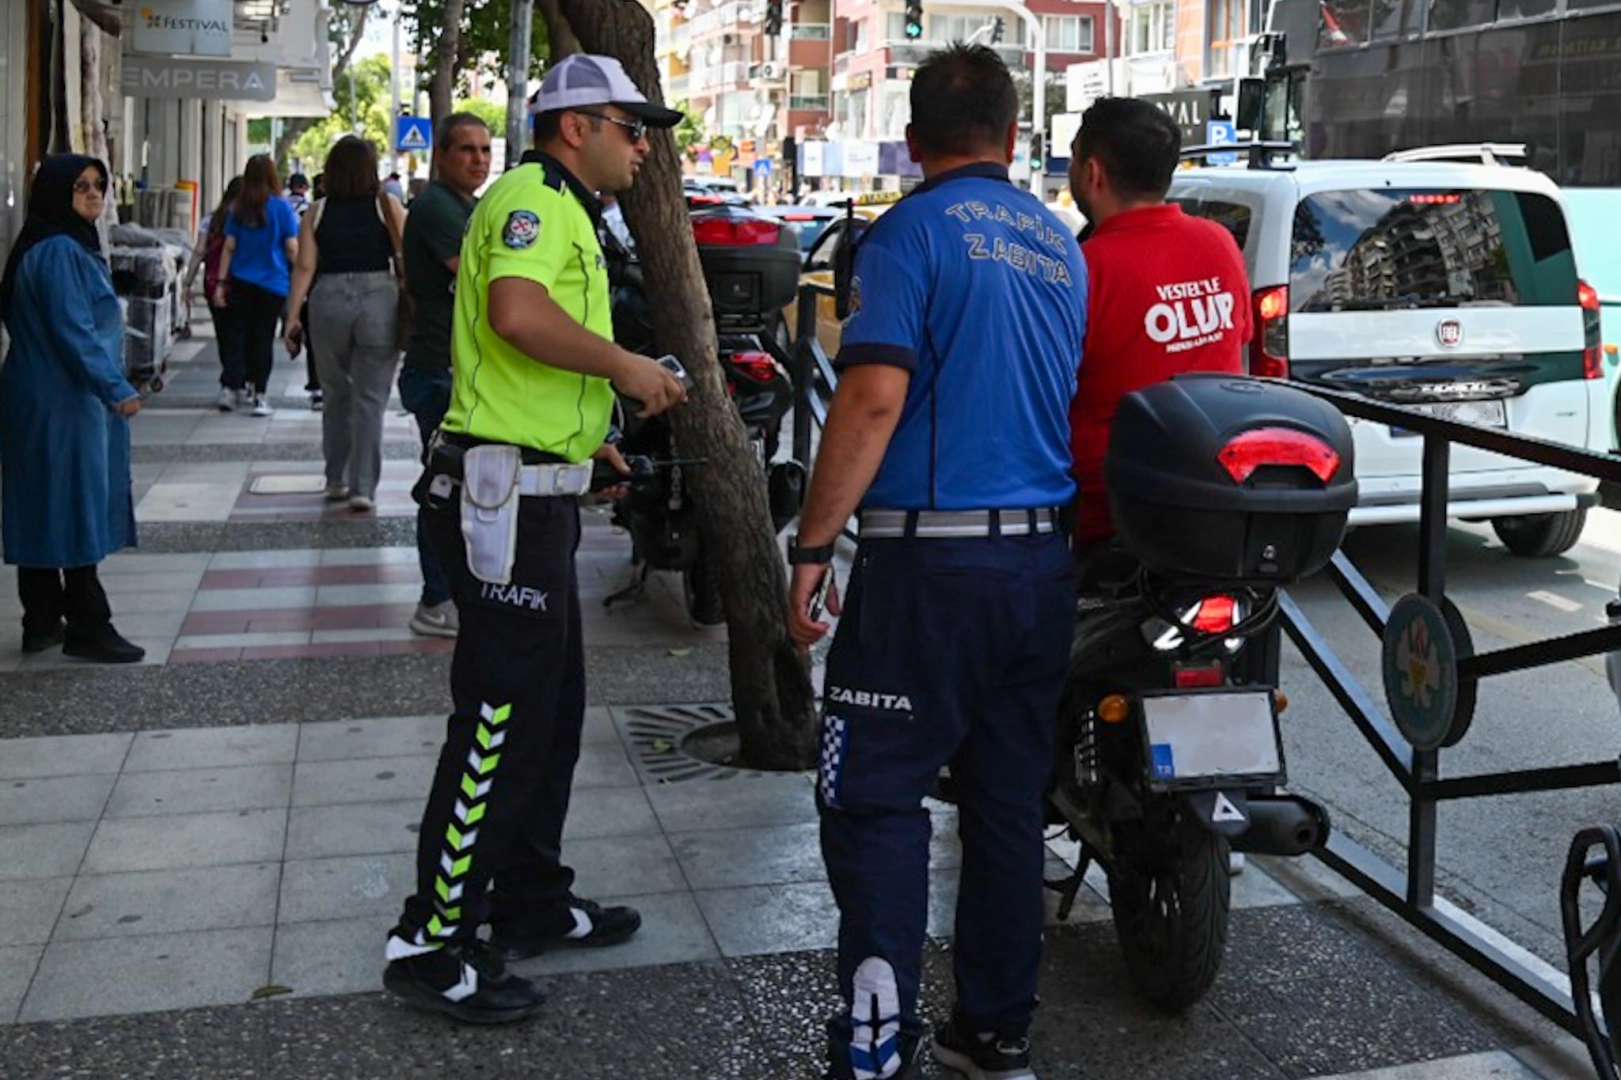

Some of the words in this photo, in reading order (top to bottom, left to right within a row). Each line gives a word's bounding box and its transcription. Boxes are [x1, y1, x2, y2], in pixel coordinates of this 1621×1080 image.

[121, 65, 266, 92] EMPERA
[962, 233, 1073, 288] ZABITA
[1144, 291, 1234, 343] OLUR
[829, 686, 912, 710] ZABITA
